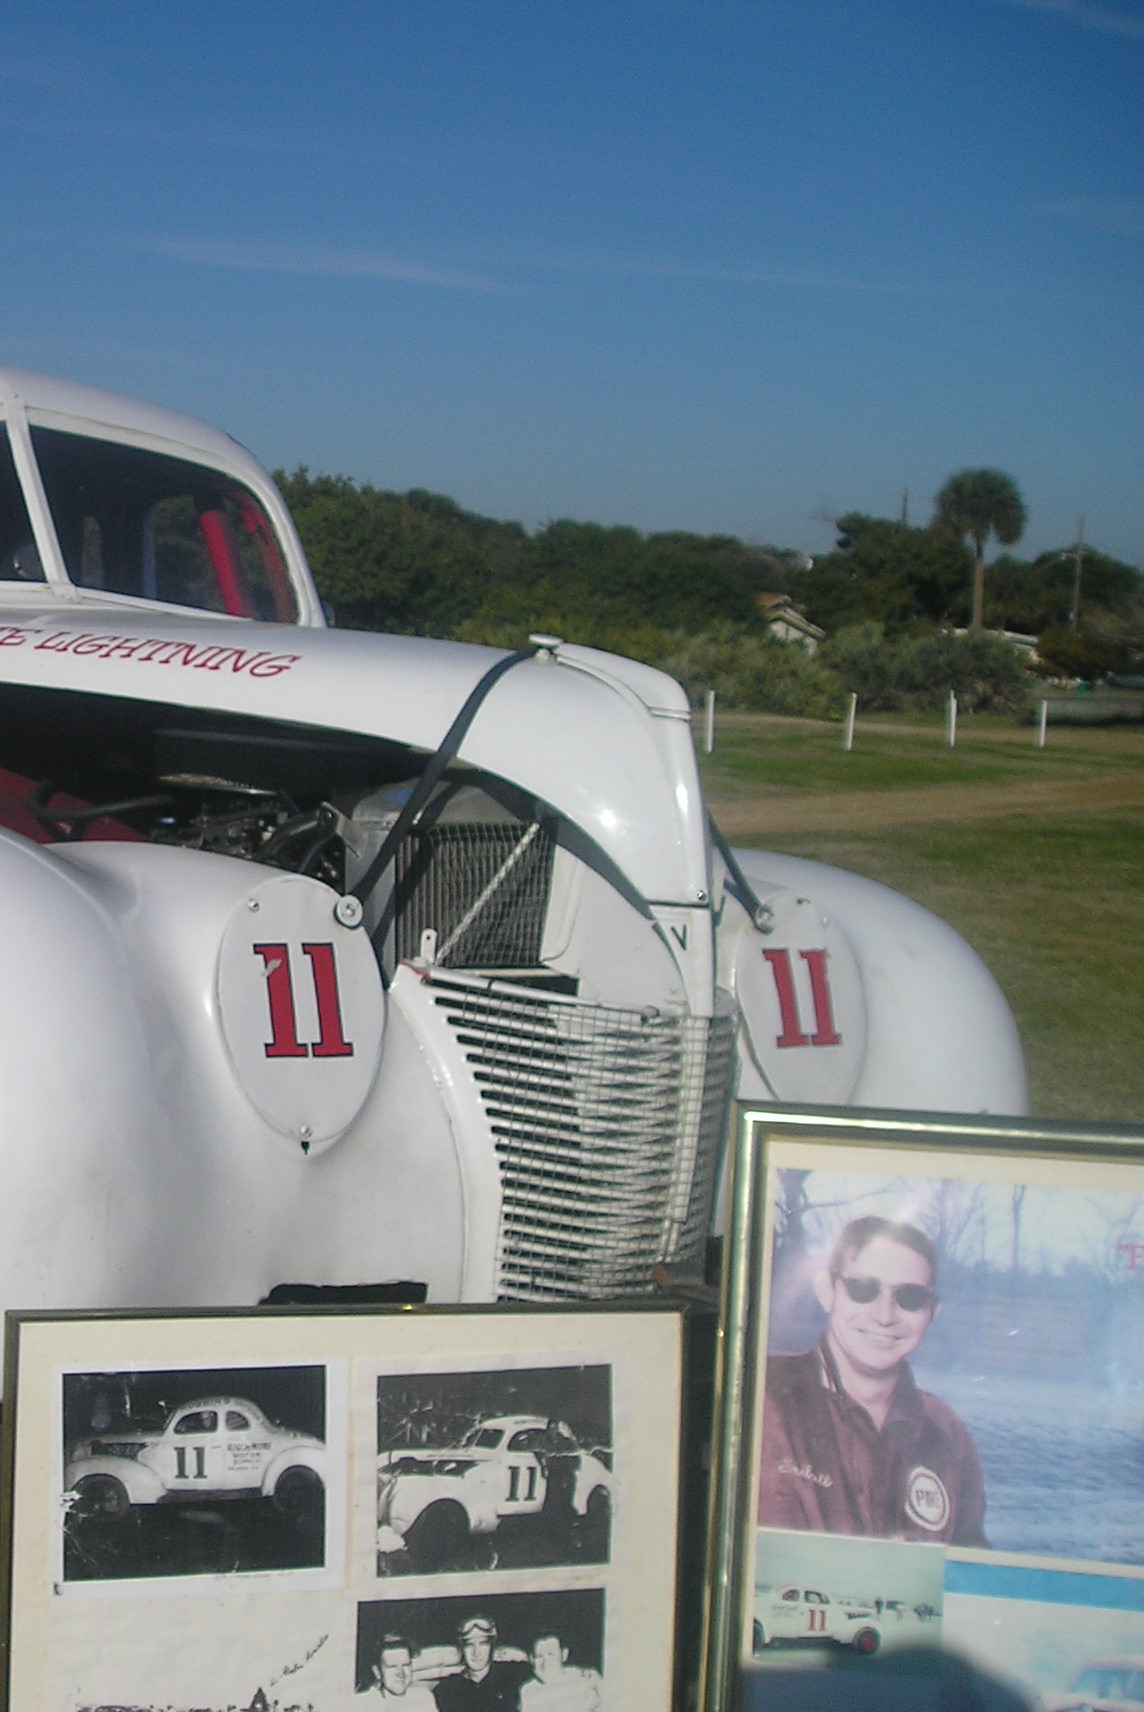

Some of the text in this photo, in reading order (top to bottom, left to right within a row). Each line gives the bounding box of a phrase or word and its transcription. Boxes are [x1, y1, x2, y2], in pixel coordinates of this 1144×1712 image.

[34, 631, 303, 678] LIGHTNING
[252, 942, 354, 1057] 11
[761, 948, 843, 1048] 11
[173, 1446, 208, 1479] 11
[504, 1465, 538, 1502] 11
[808, 1609, 827, 1632] 11
